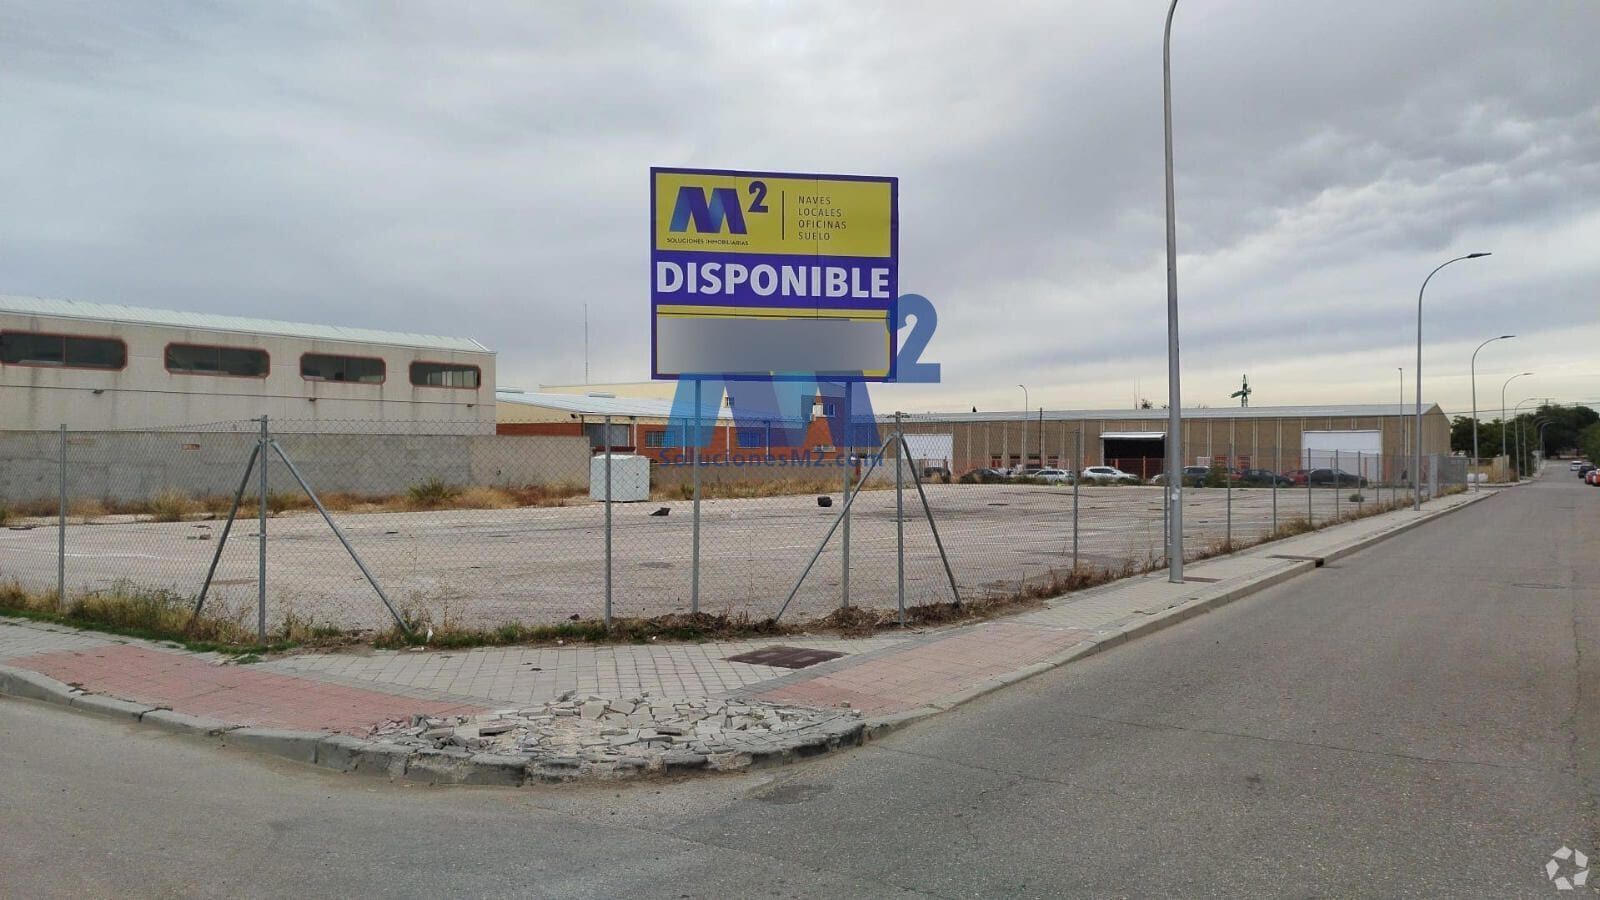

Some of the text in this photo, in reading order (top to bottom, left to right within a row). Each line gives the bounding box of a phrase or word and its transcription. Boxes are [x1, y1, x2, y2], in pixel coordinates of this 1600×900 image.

[798, 196, 831, 205] NAVES
[798, 208, 842, 218] LOCALES
[798, 220, 847, 230] OFICINAS
[666, 237, 704, 245] SOLUCIONES
[798, 231, 831, 241] SUELO
[656, 261, 890, 298] DISPONIBLE
